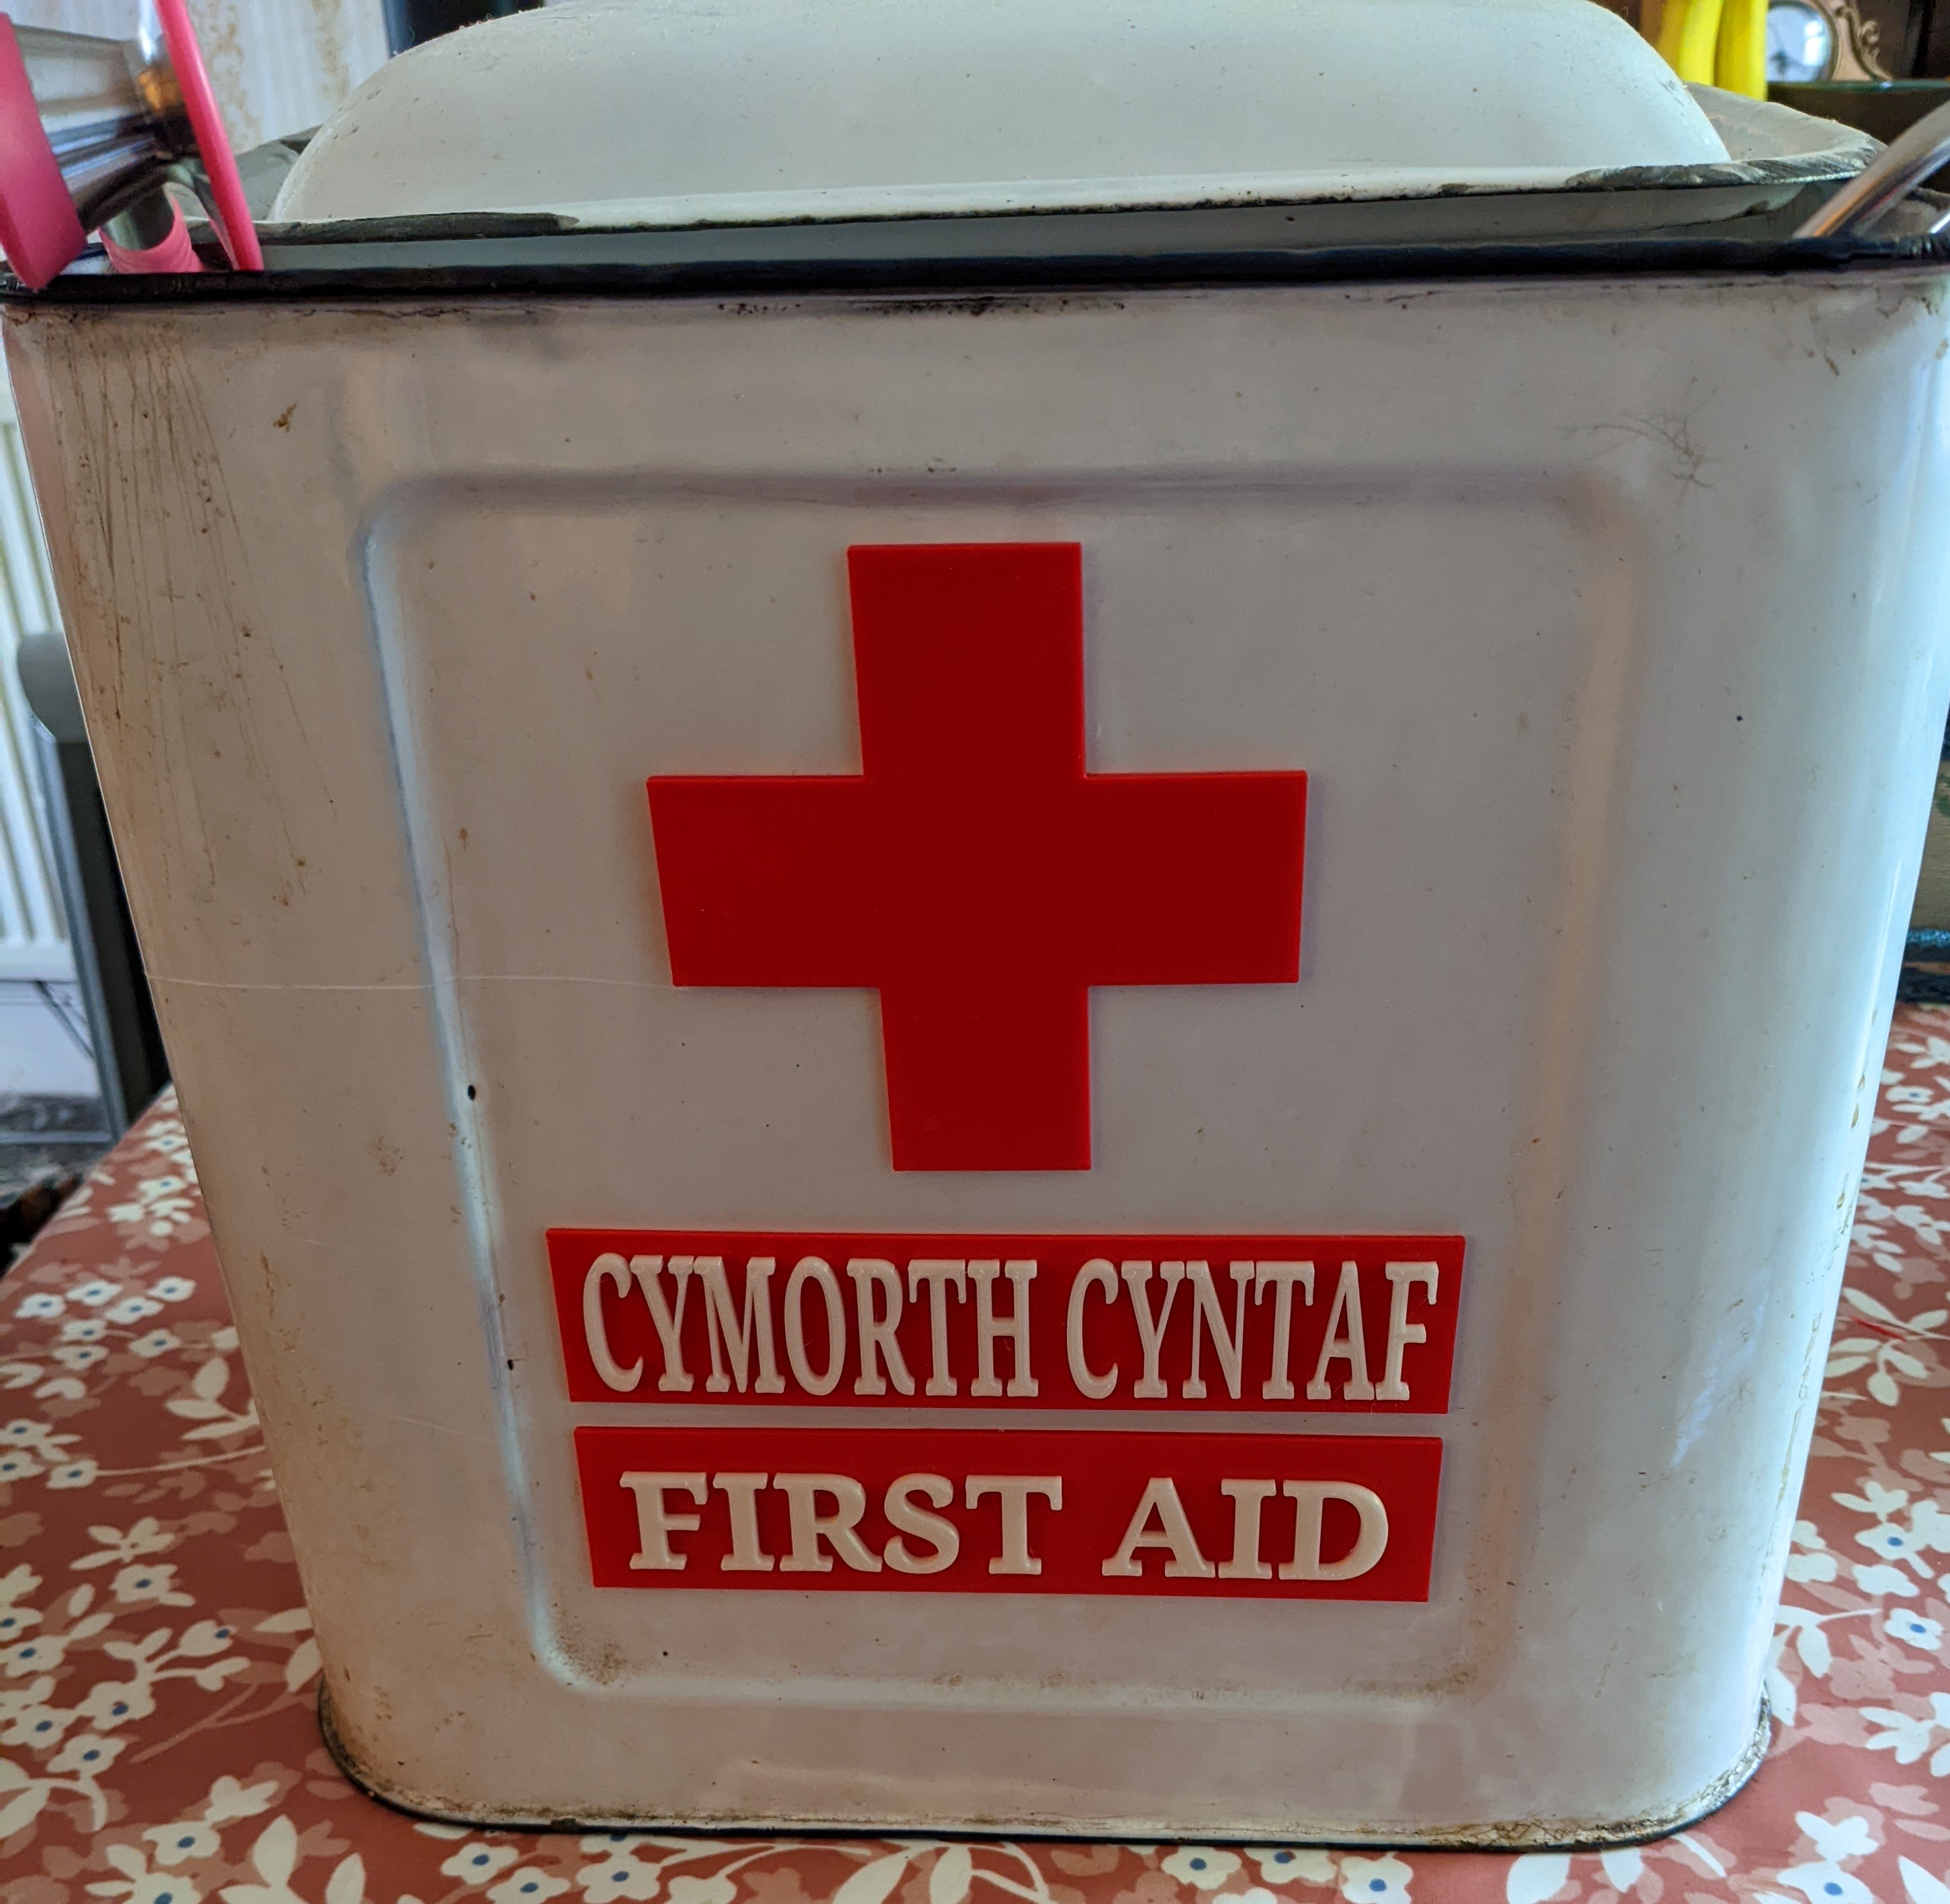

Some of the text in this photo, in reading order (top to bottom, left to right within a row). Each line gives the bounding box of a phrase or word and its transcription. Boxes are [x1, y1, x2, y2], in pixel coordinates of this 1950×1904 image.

[583, 1252, 1440, 1401] CYMORTH CYNTAF
[618, 1472, 1389, 1581] FIRST AID
